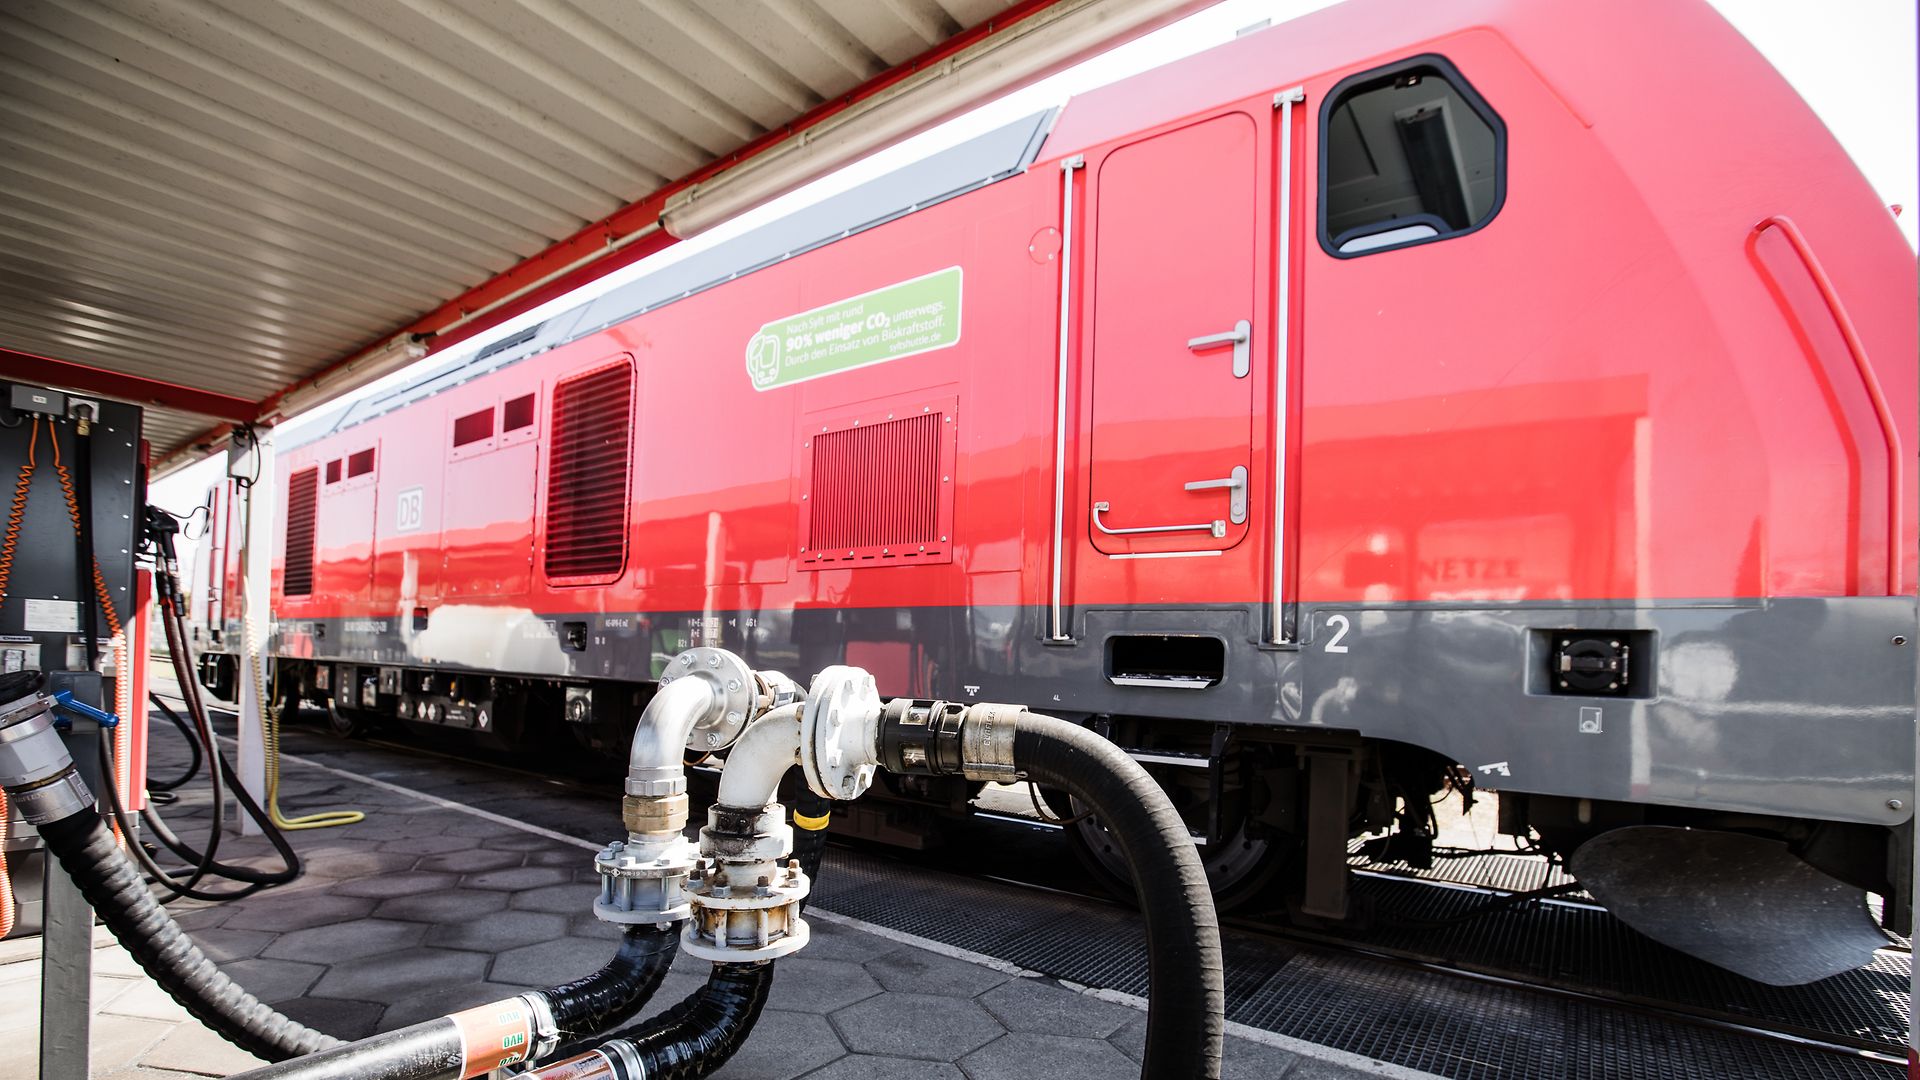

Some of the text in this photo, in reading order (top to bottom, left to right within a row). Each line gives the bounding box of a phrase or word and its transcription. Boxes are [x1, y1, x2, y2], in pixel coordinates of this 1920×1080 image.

[786, 304, 864, 334] Nach Sylt mit rund
[786, 332, 813, 353] 90%
[815, 320, 864, 345] weniger
[893, 301, 946, 323] unterwegs.
[784, 315, 944, 367] Durch den Einsatz von Biokraftstoff.
[399, 491, 422, 529] DB
[1325, 614, 1350, 653] 2
[503, 1032, 524, 1048] HVO
